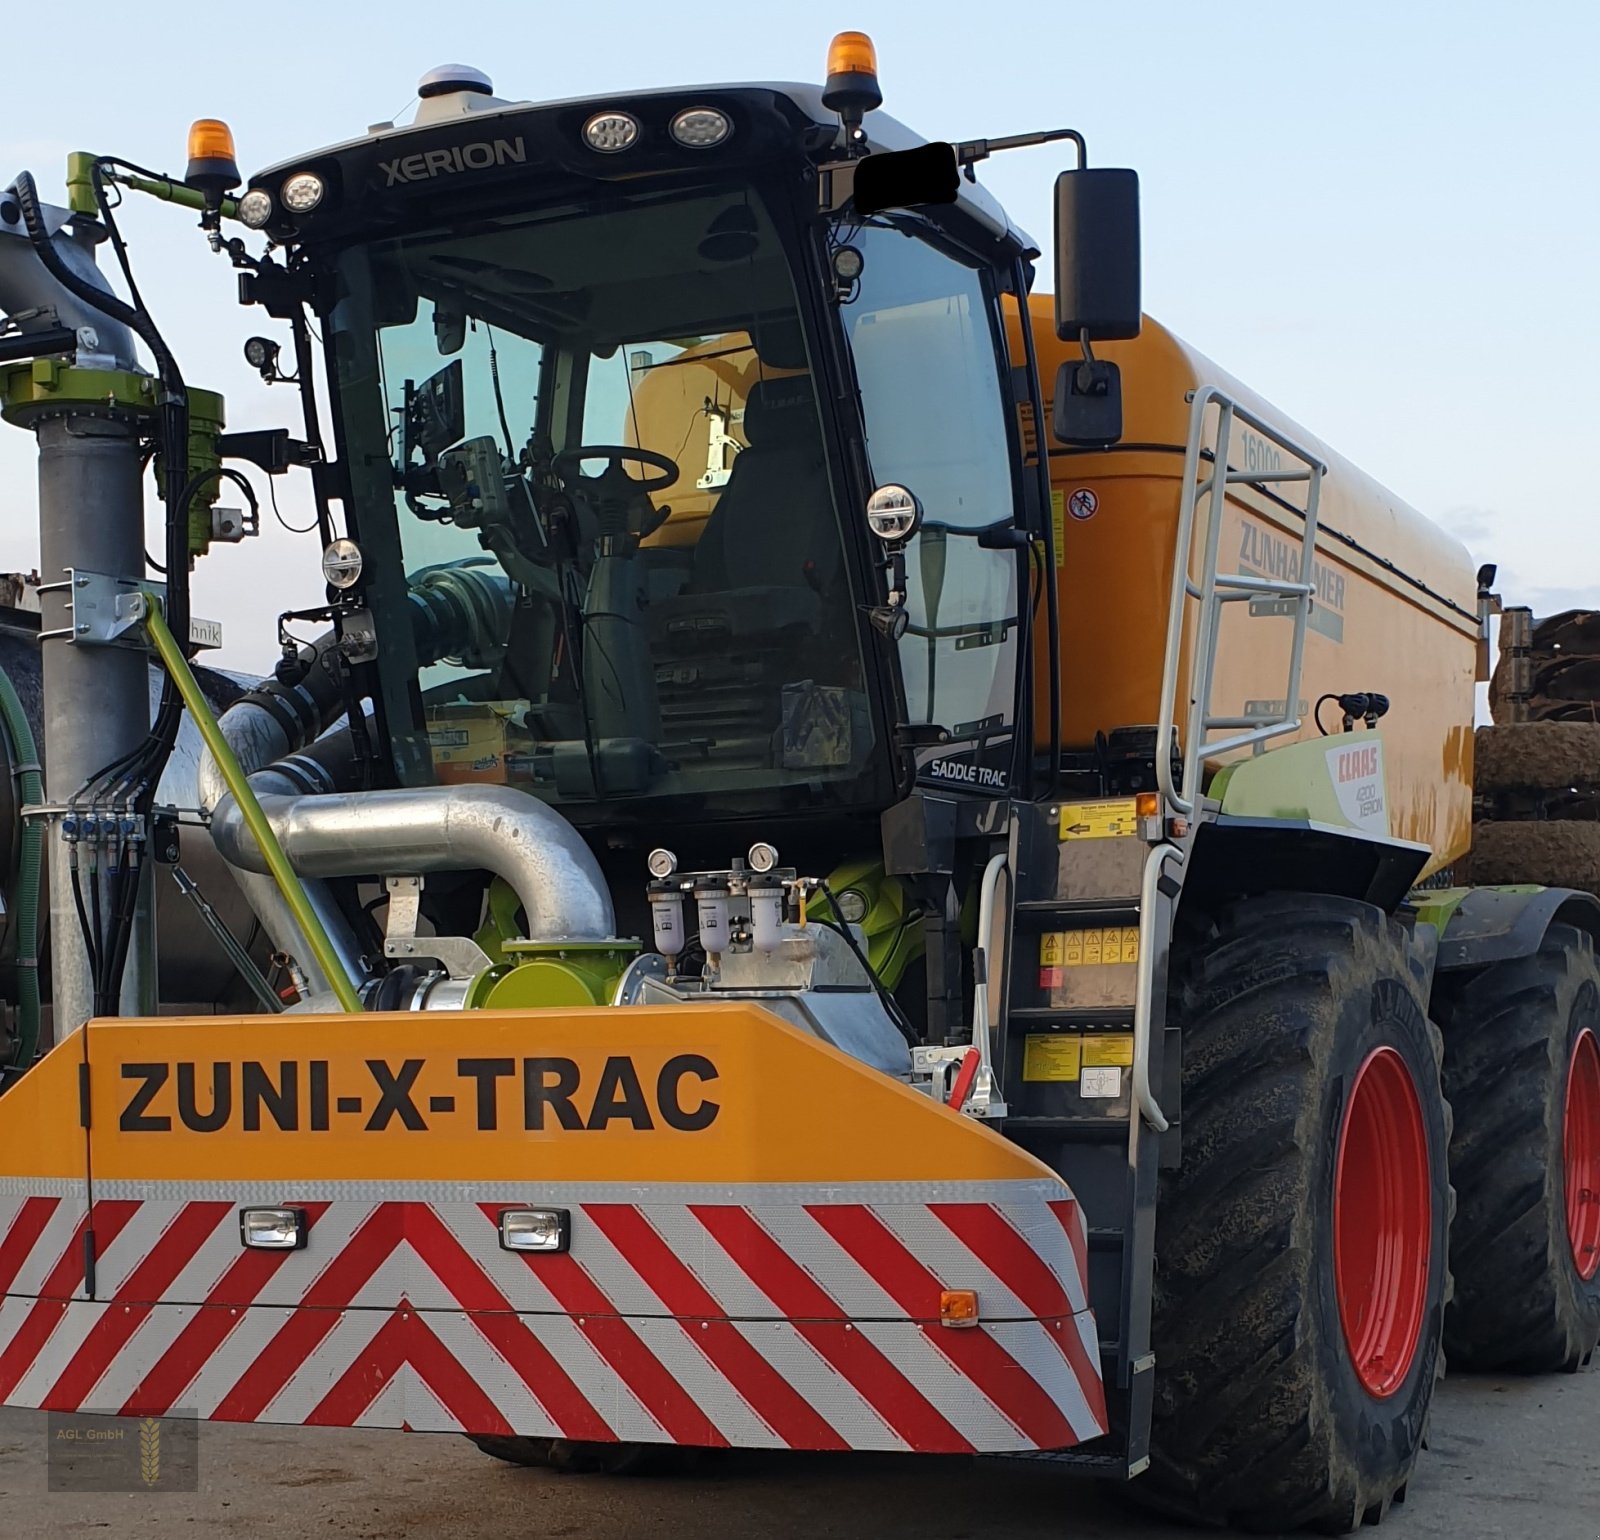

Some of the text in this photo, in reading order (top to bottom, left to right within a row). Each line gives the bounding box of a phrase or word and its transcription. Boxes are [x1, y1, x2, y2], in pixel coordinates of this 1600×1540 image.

[378, 136, 526, 187] XERION
[1241, 430, 1281, 488] 16000
[1239, 519, 1345, 611] ZUNHAMER
[931, 760, 1007, 787] SADDLE TRAC
[1338, 747, 1377, 783] CLAAS
[119, 1054, 721, 1133] ZUNI-X-TRAC
